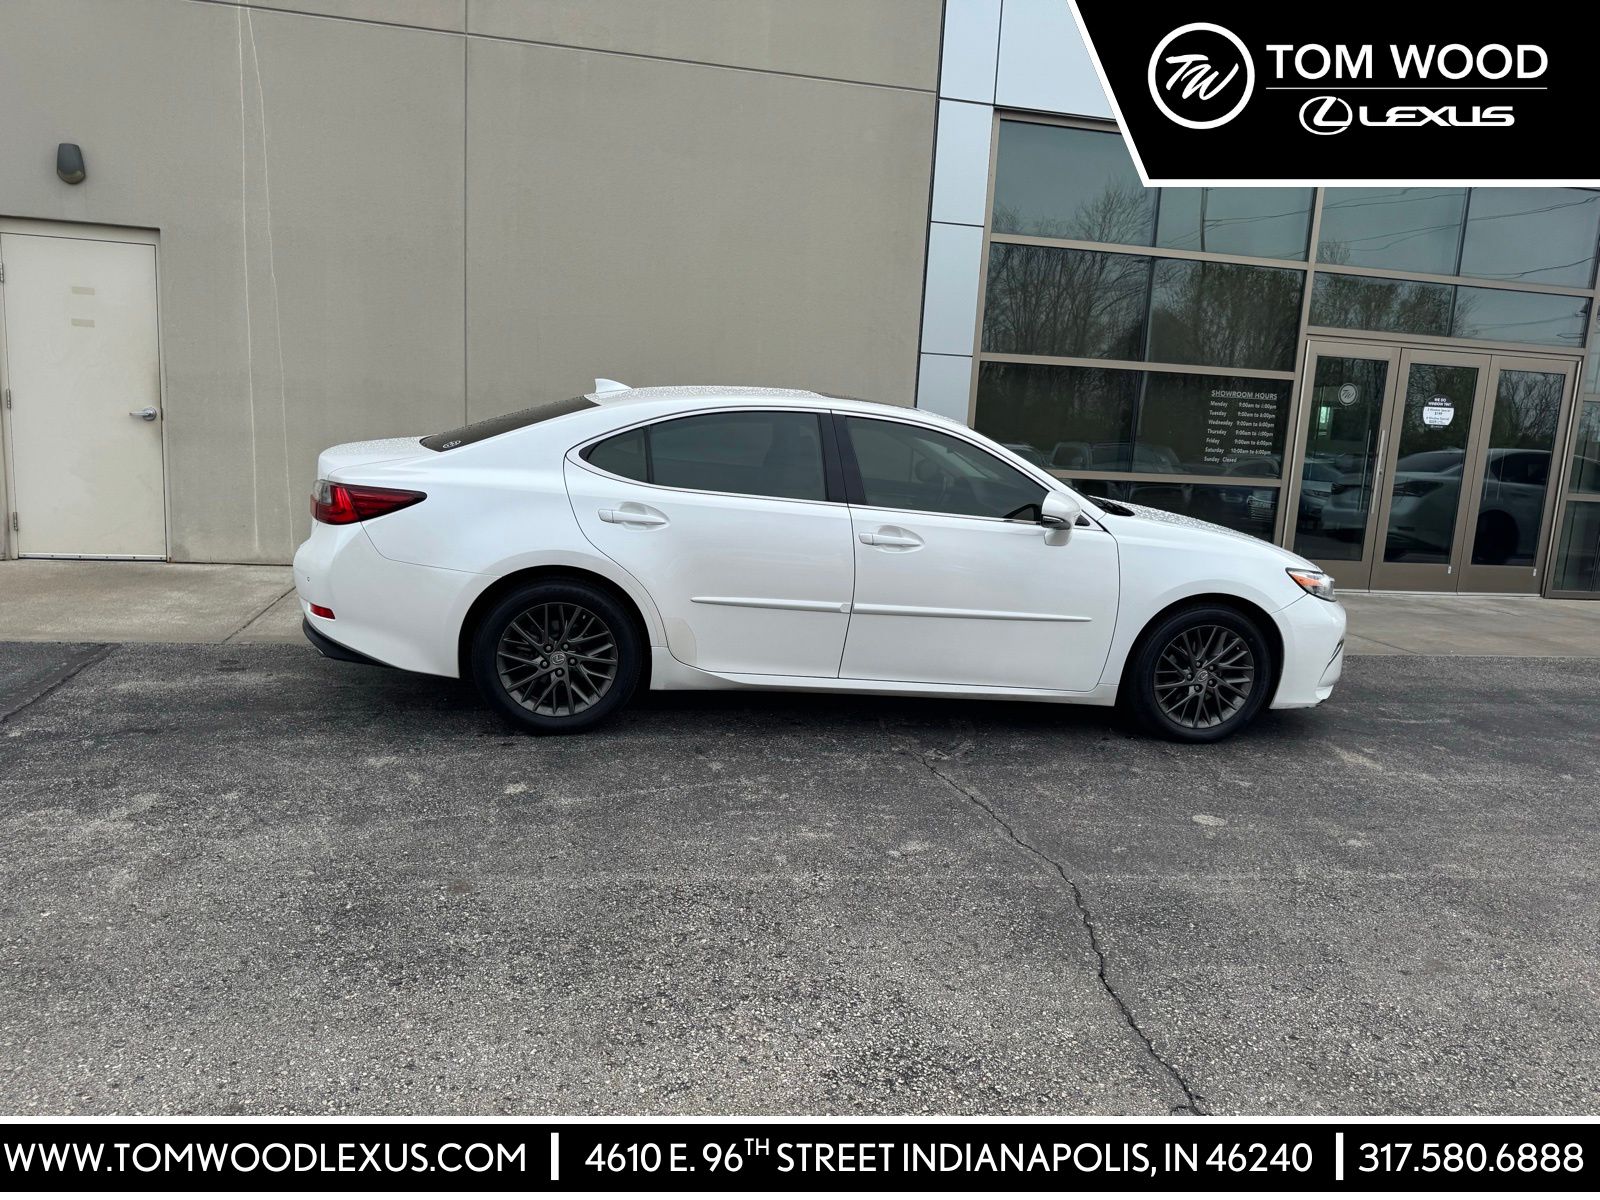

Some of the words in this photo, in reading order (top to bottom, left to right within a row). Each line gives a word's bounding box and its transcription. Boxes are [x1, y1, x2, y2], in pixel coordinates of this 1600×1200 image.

[1211, 390, 1253, 399] SHOWROOM
[1210, 400, 1228, 408] Monday
[1209, 409, 1227, 417] Tuesday
[1208, 419, 1234, 427] Wednesday
[1207, 428, 1227, 436] Thursday
[1206, 437, 1220, 445] Friday
[1205, 446, 1225, 454] Saturday
